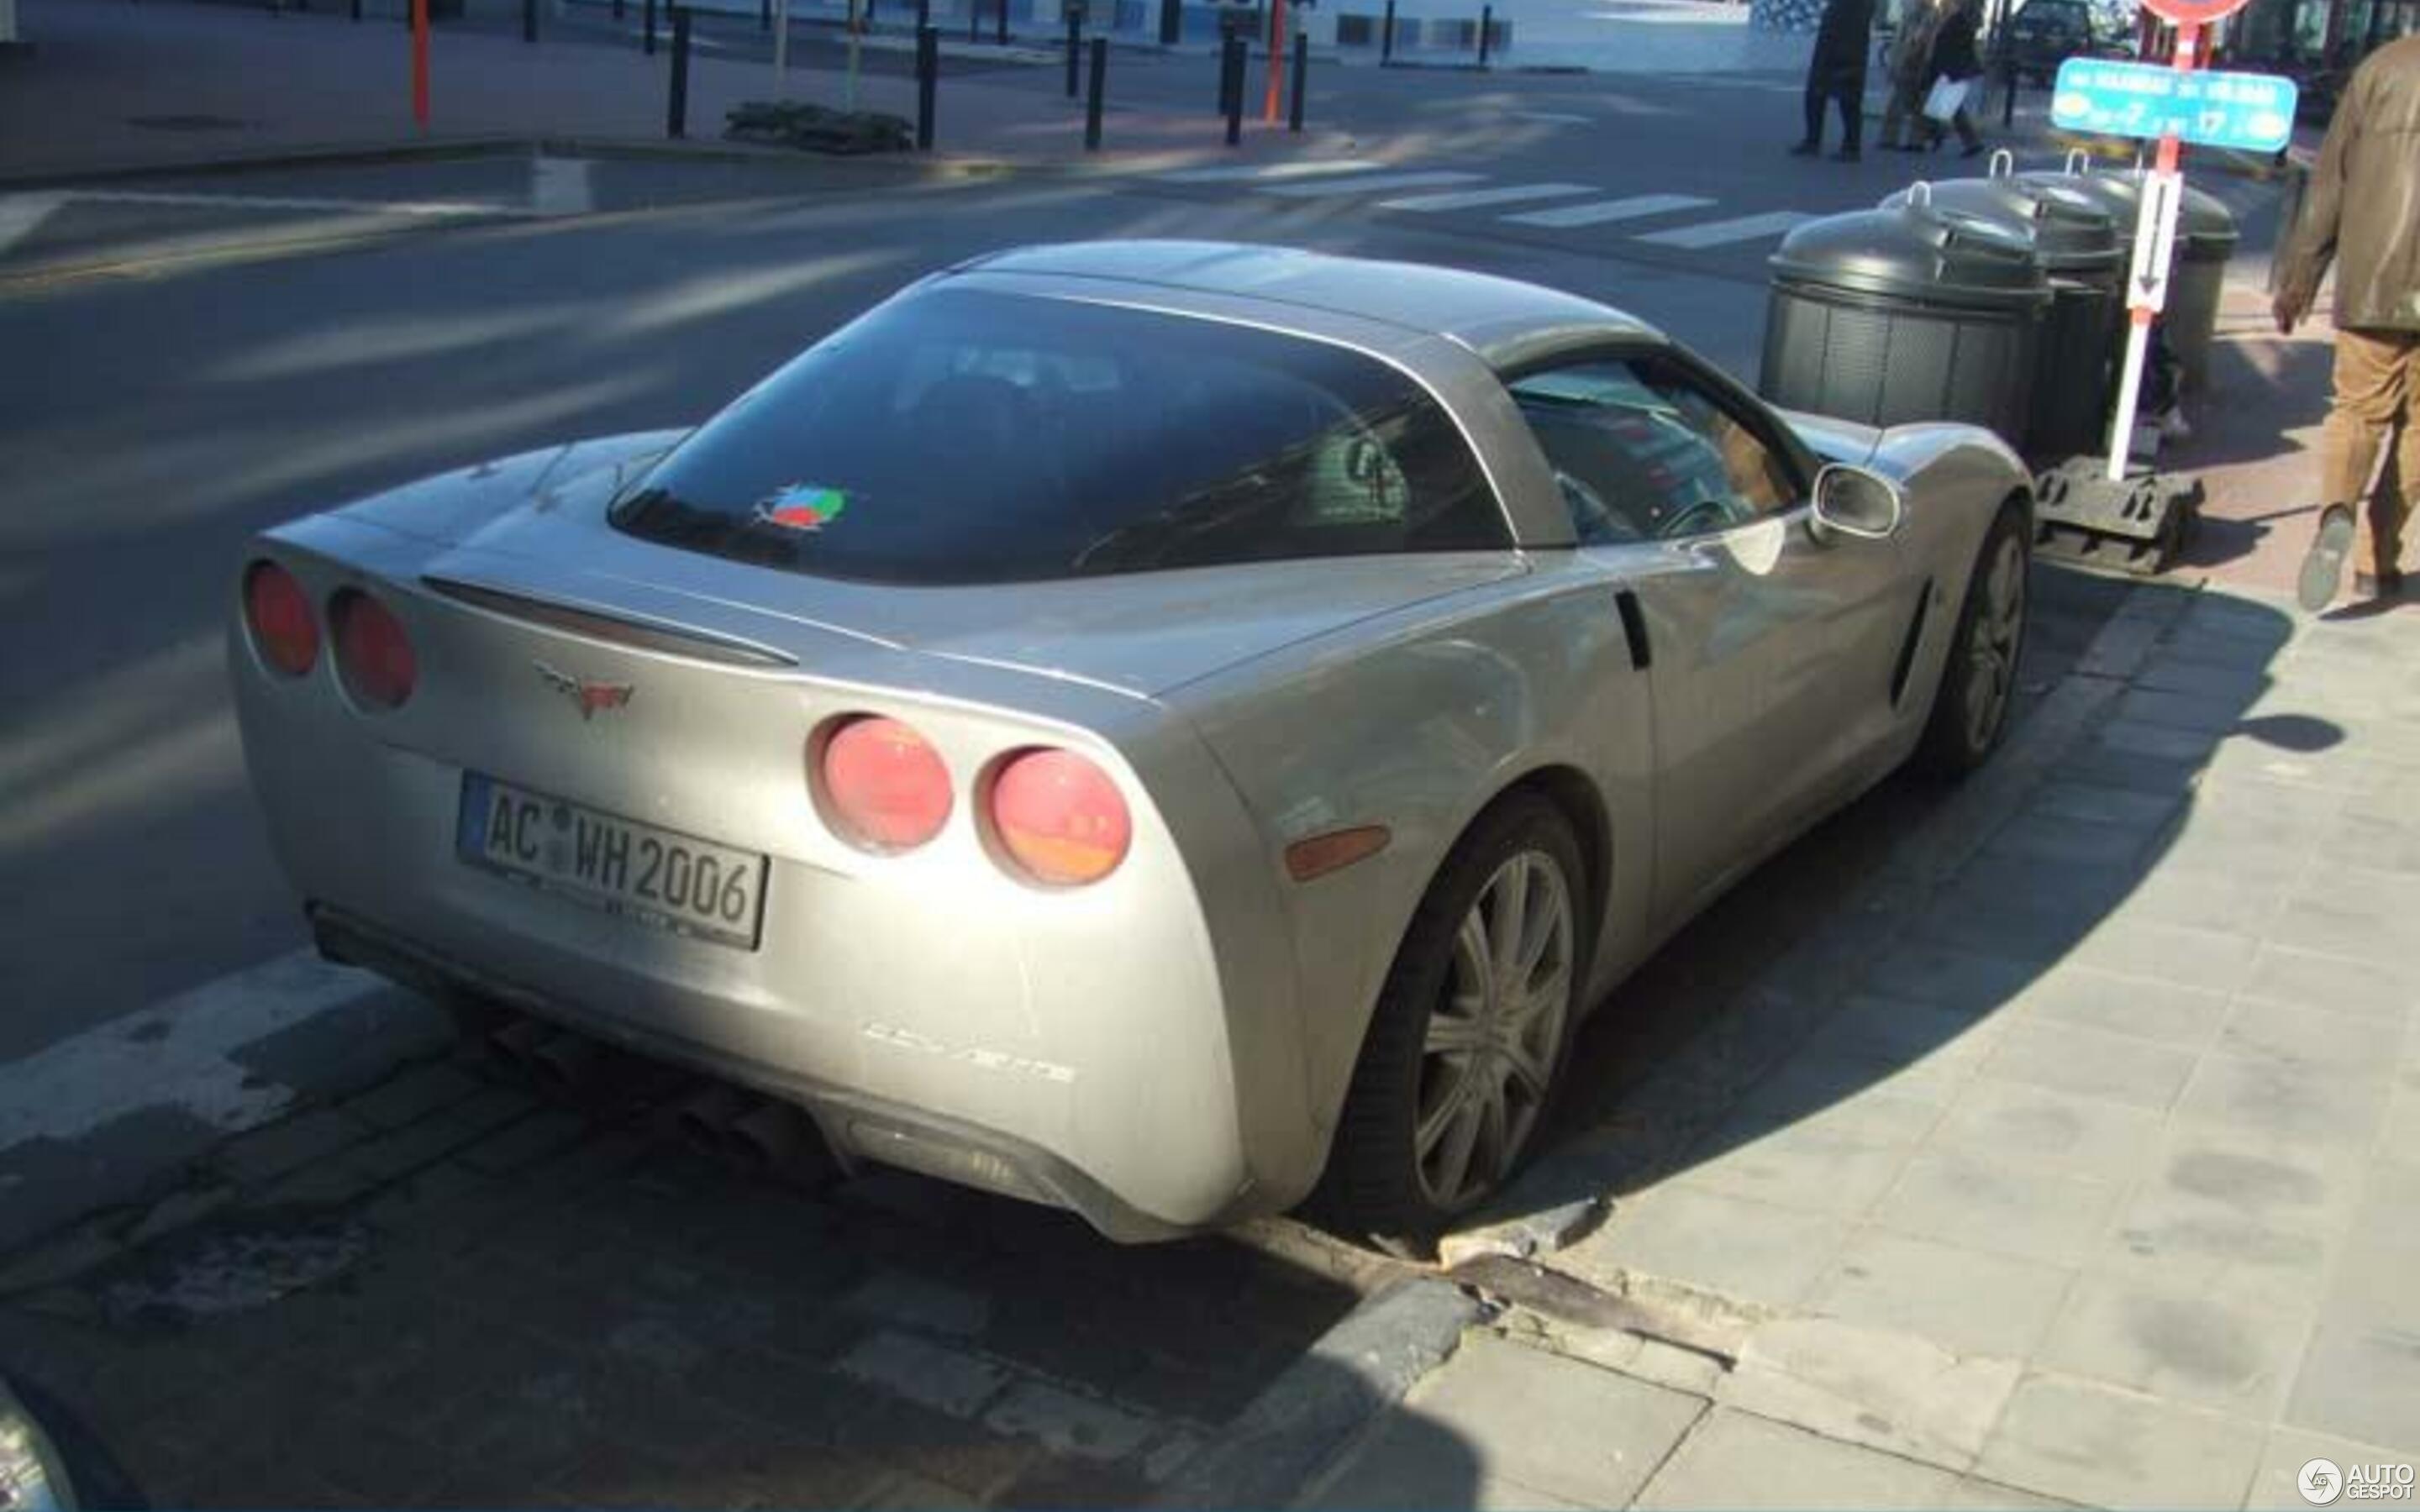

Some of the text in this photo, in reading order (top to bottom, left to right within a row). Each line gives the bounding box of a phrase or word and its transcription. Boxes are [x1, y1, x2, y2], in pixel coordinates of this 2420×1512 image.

[489, 795, 541, 862] AC
[576, 816, 630, 891] WH
[635, 837, 748, 922] 2006
